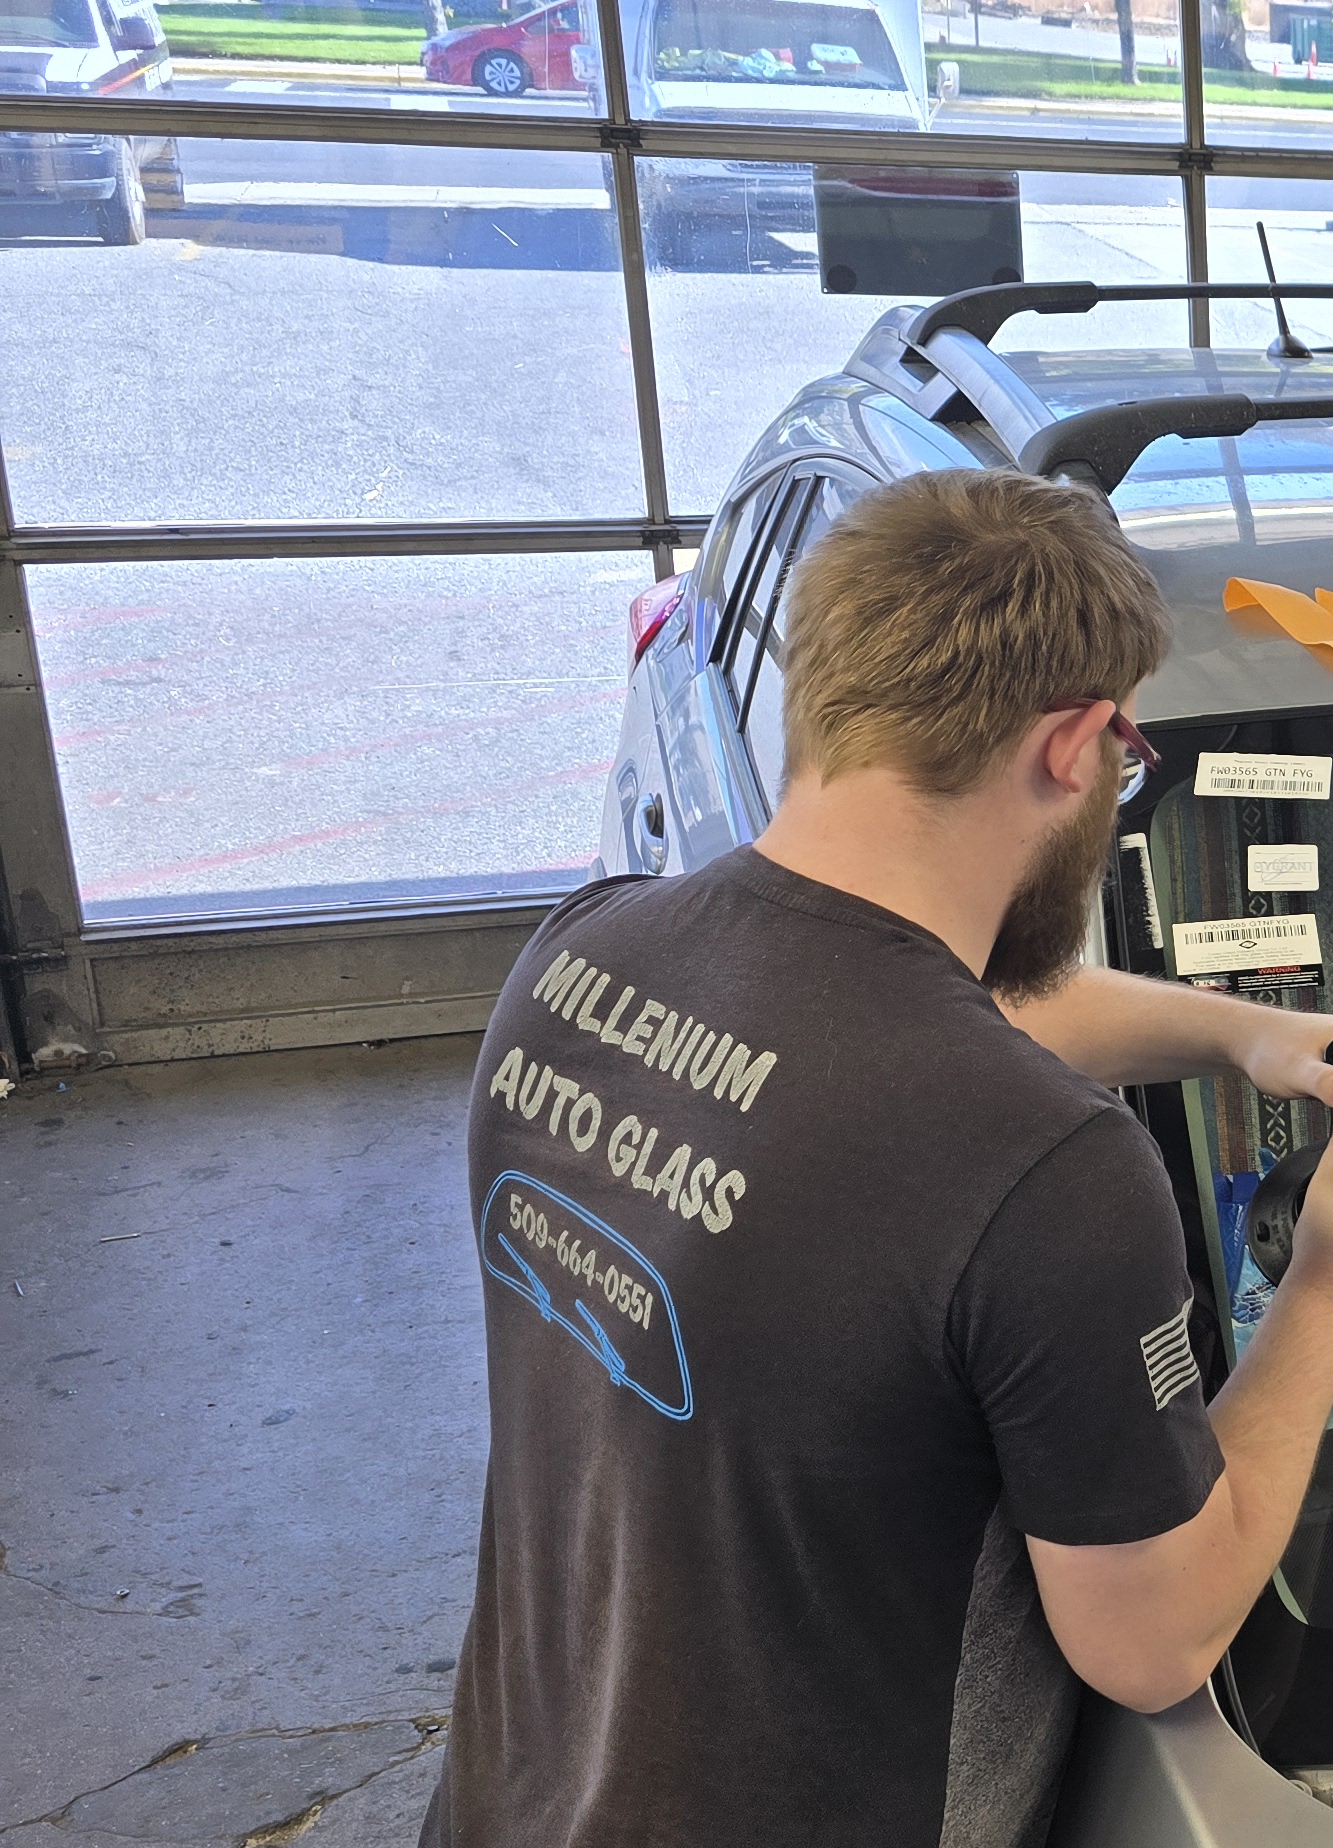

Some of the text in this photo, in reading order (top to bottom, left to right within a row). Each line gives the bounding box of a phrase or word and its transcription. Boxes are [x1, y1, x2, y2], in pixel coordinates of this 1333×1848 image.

[1264, 767, 1287, 778] GTN
[1292, 768, 1314, 779] FYG
[533, 949, 777, 1112] MILLENIUM
[1257, 965, 1302, 976] WARNING
[490, 1046, 746, 1234] AUTO GLASS
[508, 1192, 654, 1331] 509-664-0551
